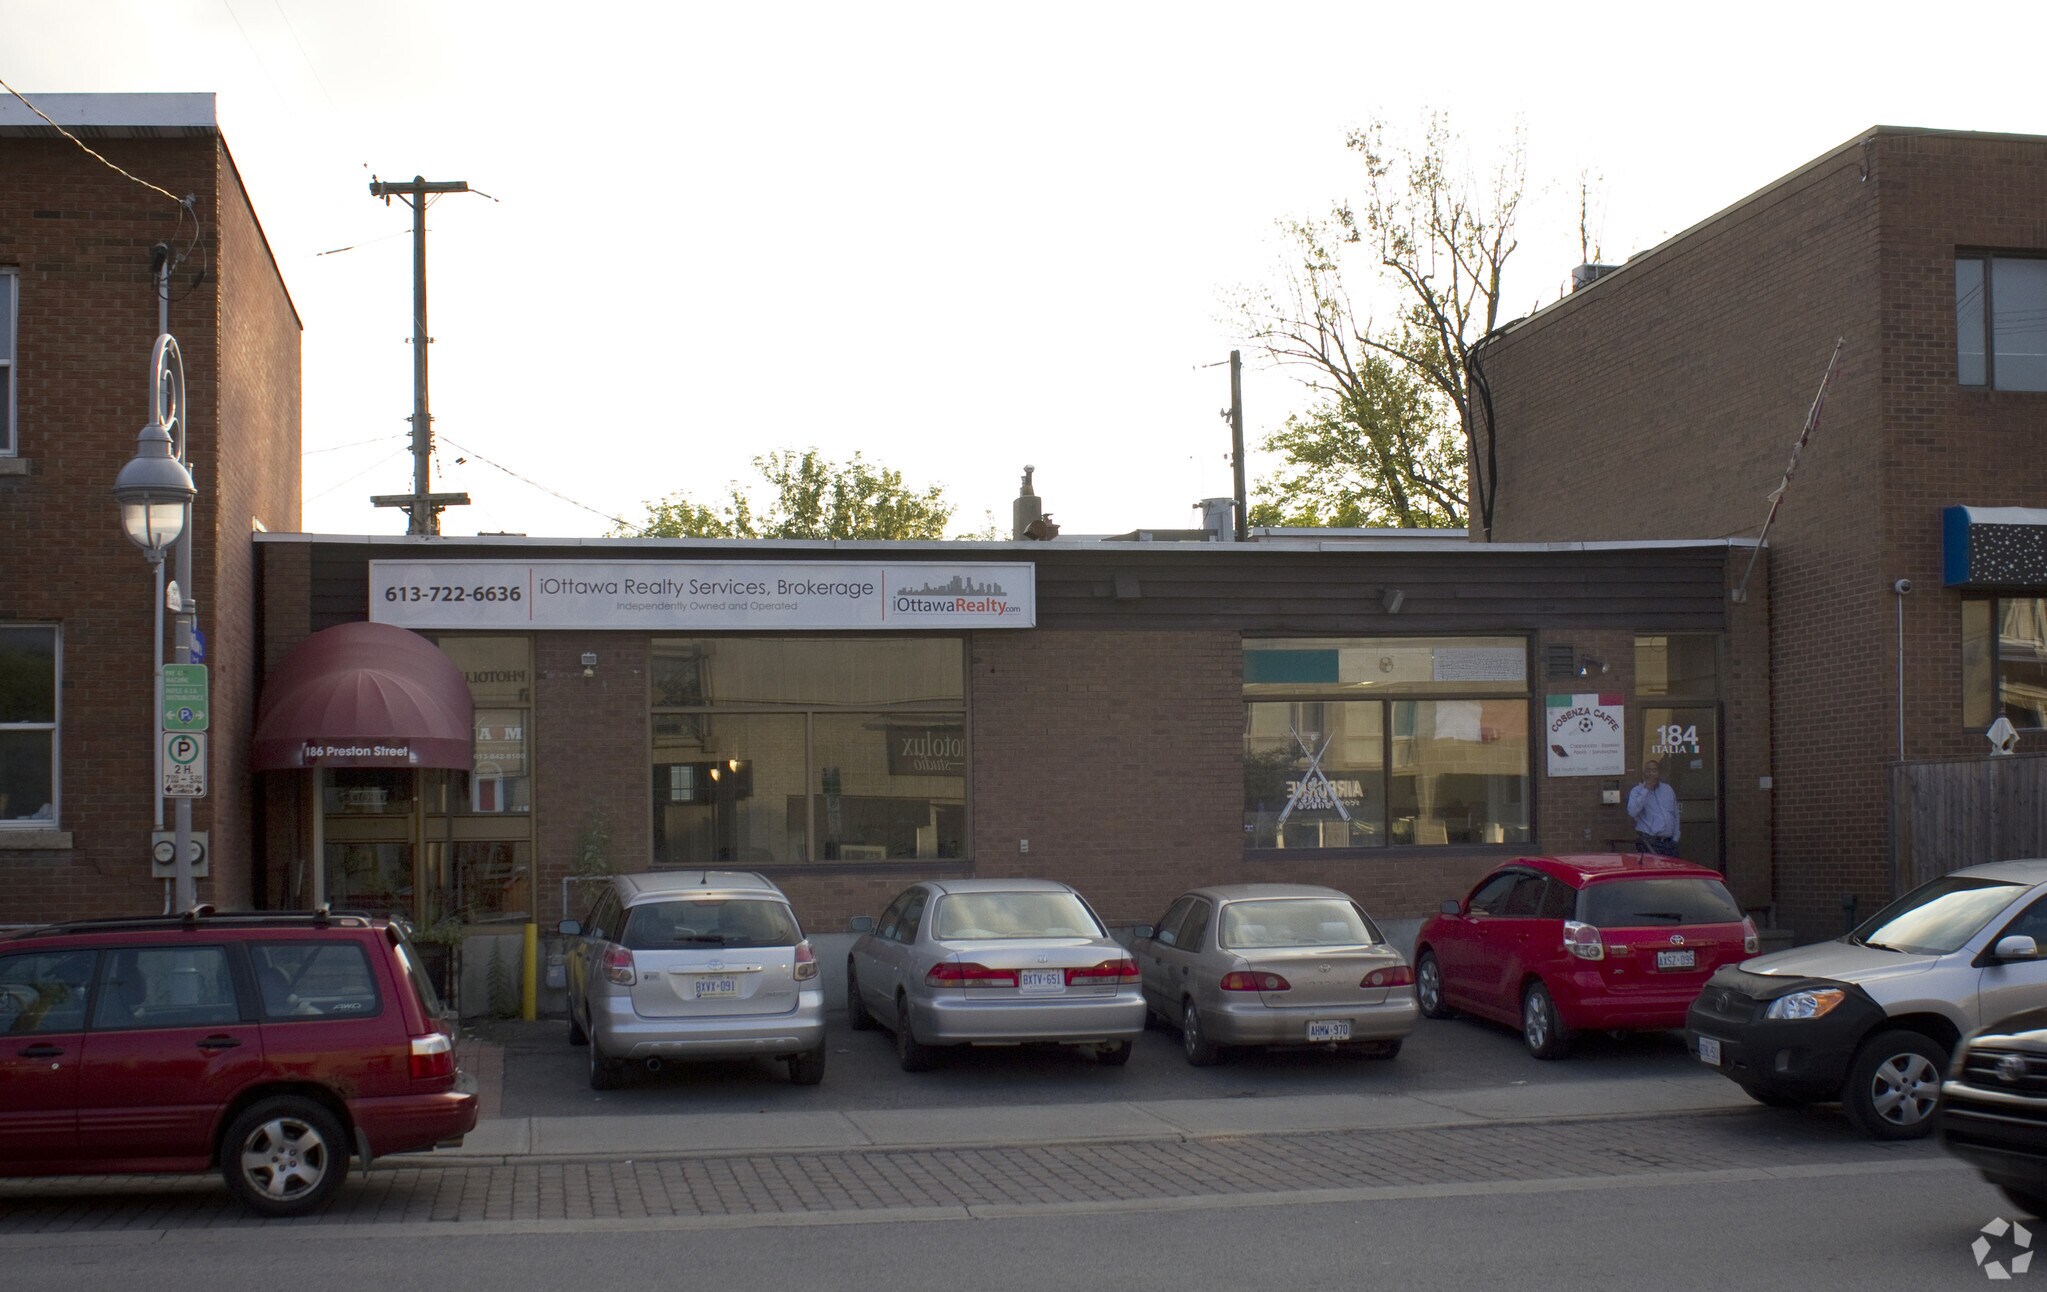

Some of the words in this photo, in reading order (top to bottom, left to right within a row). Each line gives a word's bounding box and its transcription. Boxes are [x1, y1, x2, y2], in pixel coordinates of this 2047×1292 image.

[384, 585, 522, 602] 613-722-6636
[539, 577, 618, 595] iOttawa
[624, 578, 683, 598] Realty
[688, 578, 771, 597] Services,
[777, 578, 874, 599] Brokerage
[616, 601, 688, 612] Independently
[689, 601, 727, 611] Owned
[728, 601, 748, 611] and
[750, 601, 798, 612] Operated
[892, 595, 1021, 616] iOttawaRealty.com
[1551, 707, 1592, 733] COSENZA
[1593, 708, 1620, 732] CAFFE
[1656, 724, 1699, 746] 184
[178, 741, 191, 757] P
[305, 746, 324, 757] 186
[326, 745, 371, 757] Preston
[373, 746, 409, 757] Street
[1651, 744, 1687, 754] ITALIA
[174, 764, 181, 774] 2
